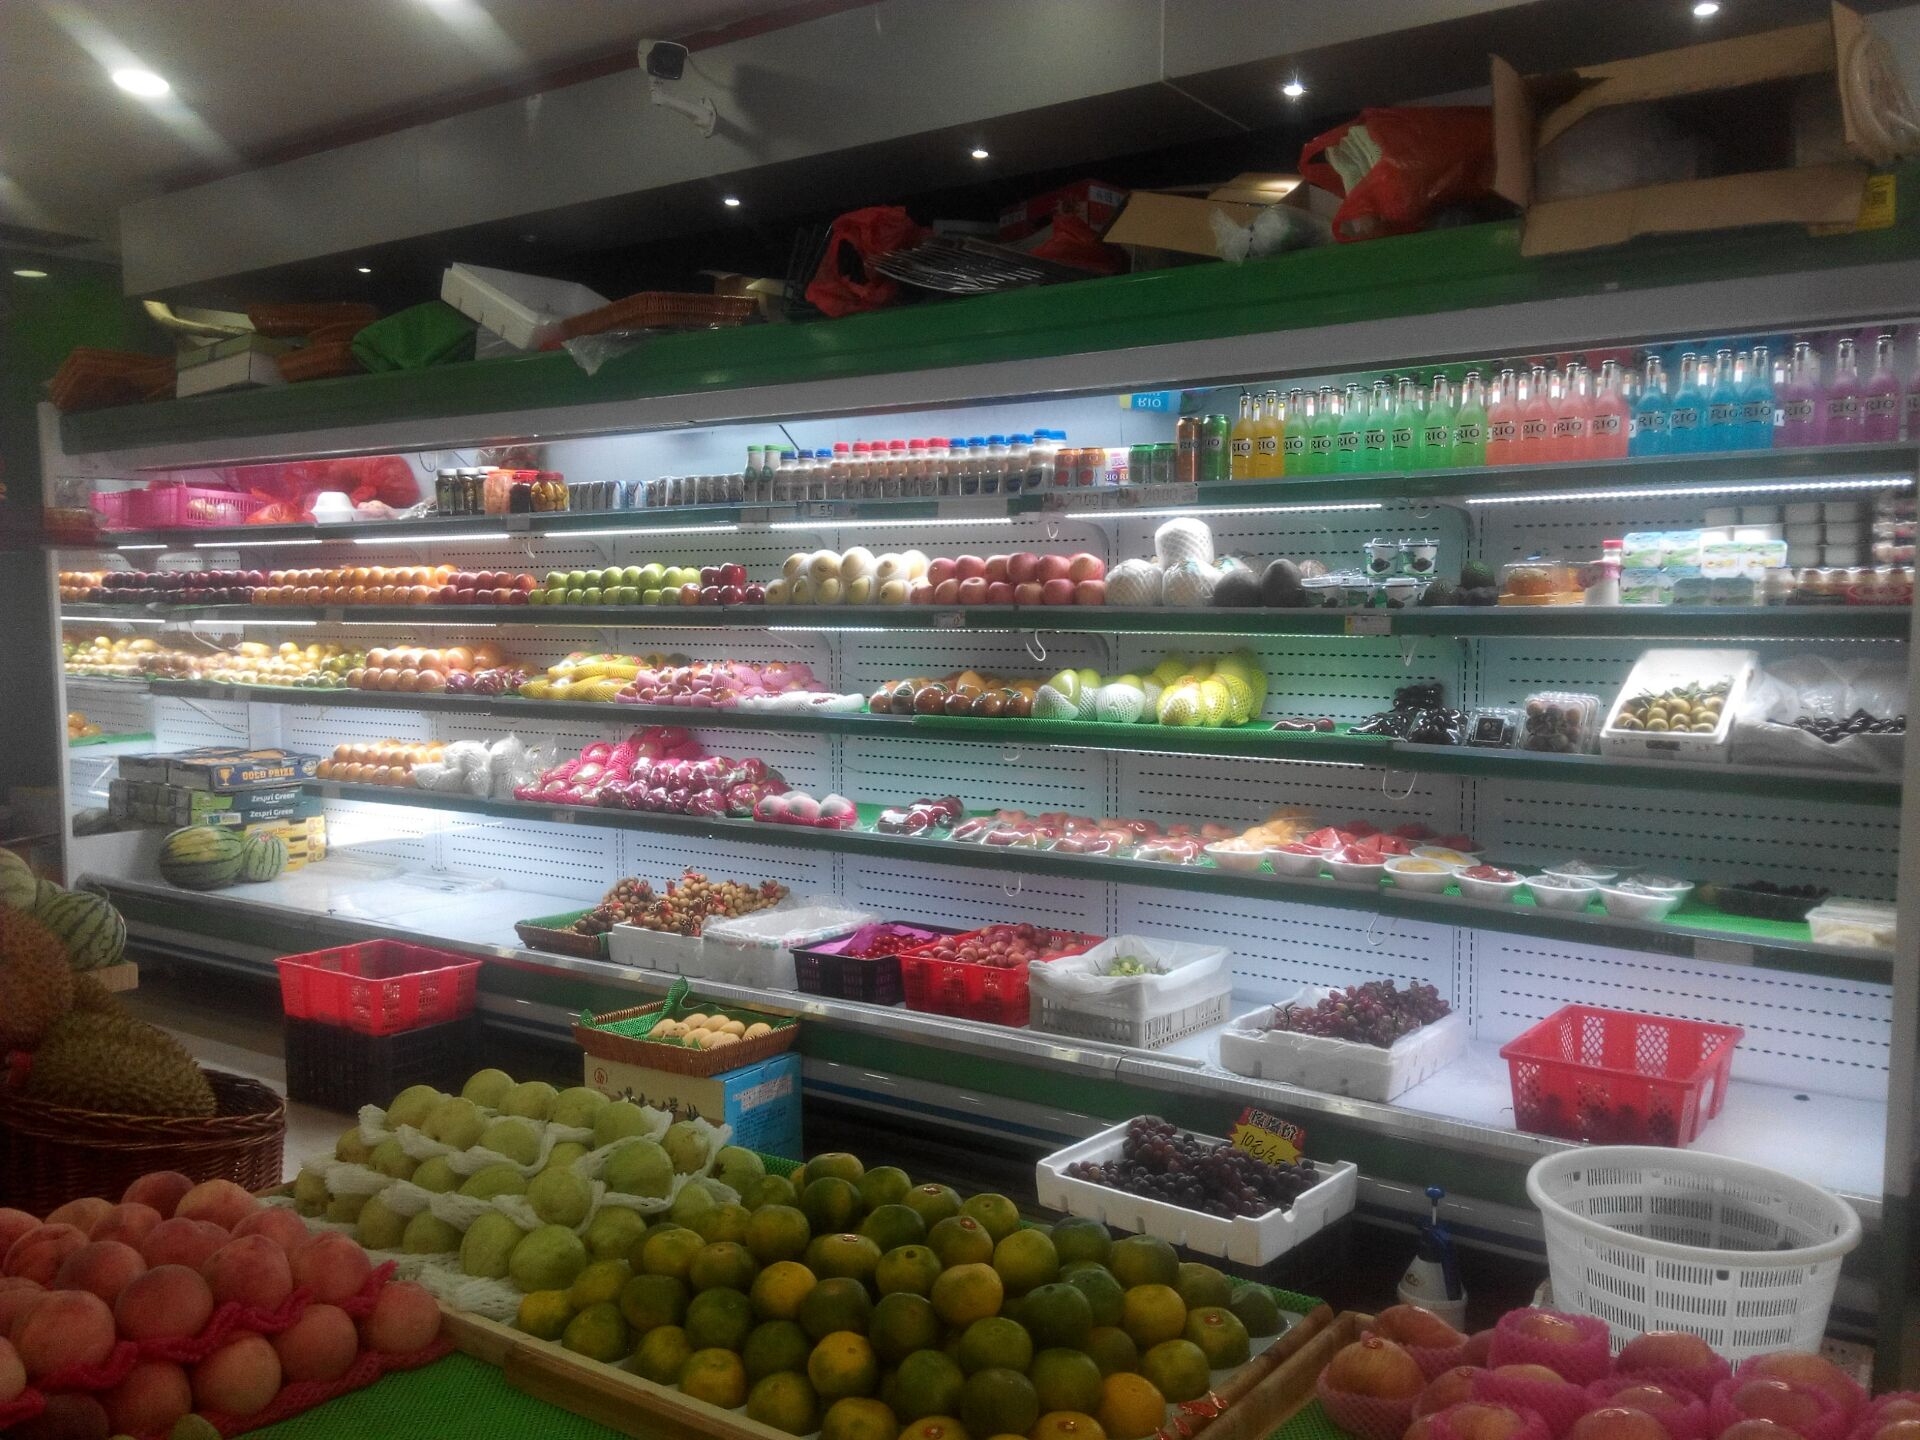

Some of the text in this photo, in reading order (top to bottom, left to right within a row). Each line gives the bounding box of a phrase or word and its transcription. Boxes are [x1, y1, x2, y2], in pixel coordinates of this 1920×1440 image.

[1522, 423, 1547, 434] RIO
[1557, 421, 1582, 432] RIO
[1592, 419, 1617, 430] RIO
[1425, 430, 1447, 441] RIO
[1456, 428, 1480, 440] RIO
[1492, 425, 1515, 436] RIO
[1206, 438, 1220, 448] IO
[1311, 440, 1331, 449] RIO
[1364, 434, 1385, 444] RIO
[251, 792, 295, 803] Zespri Green
[250, 808, 294, 818] Zespri Green
